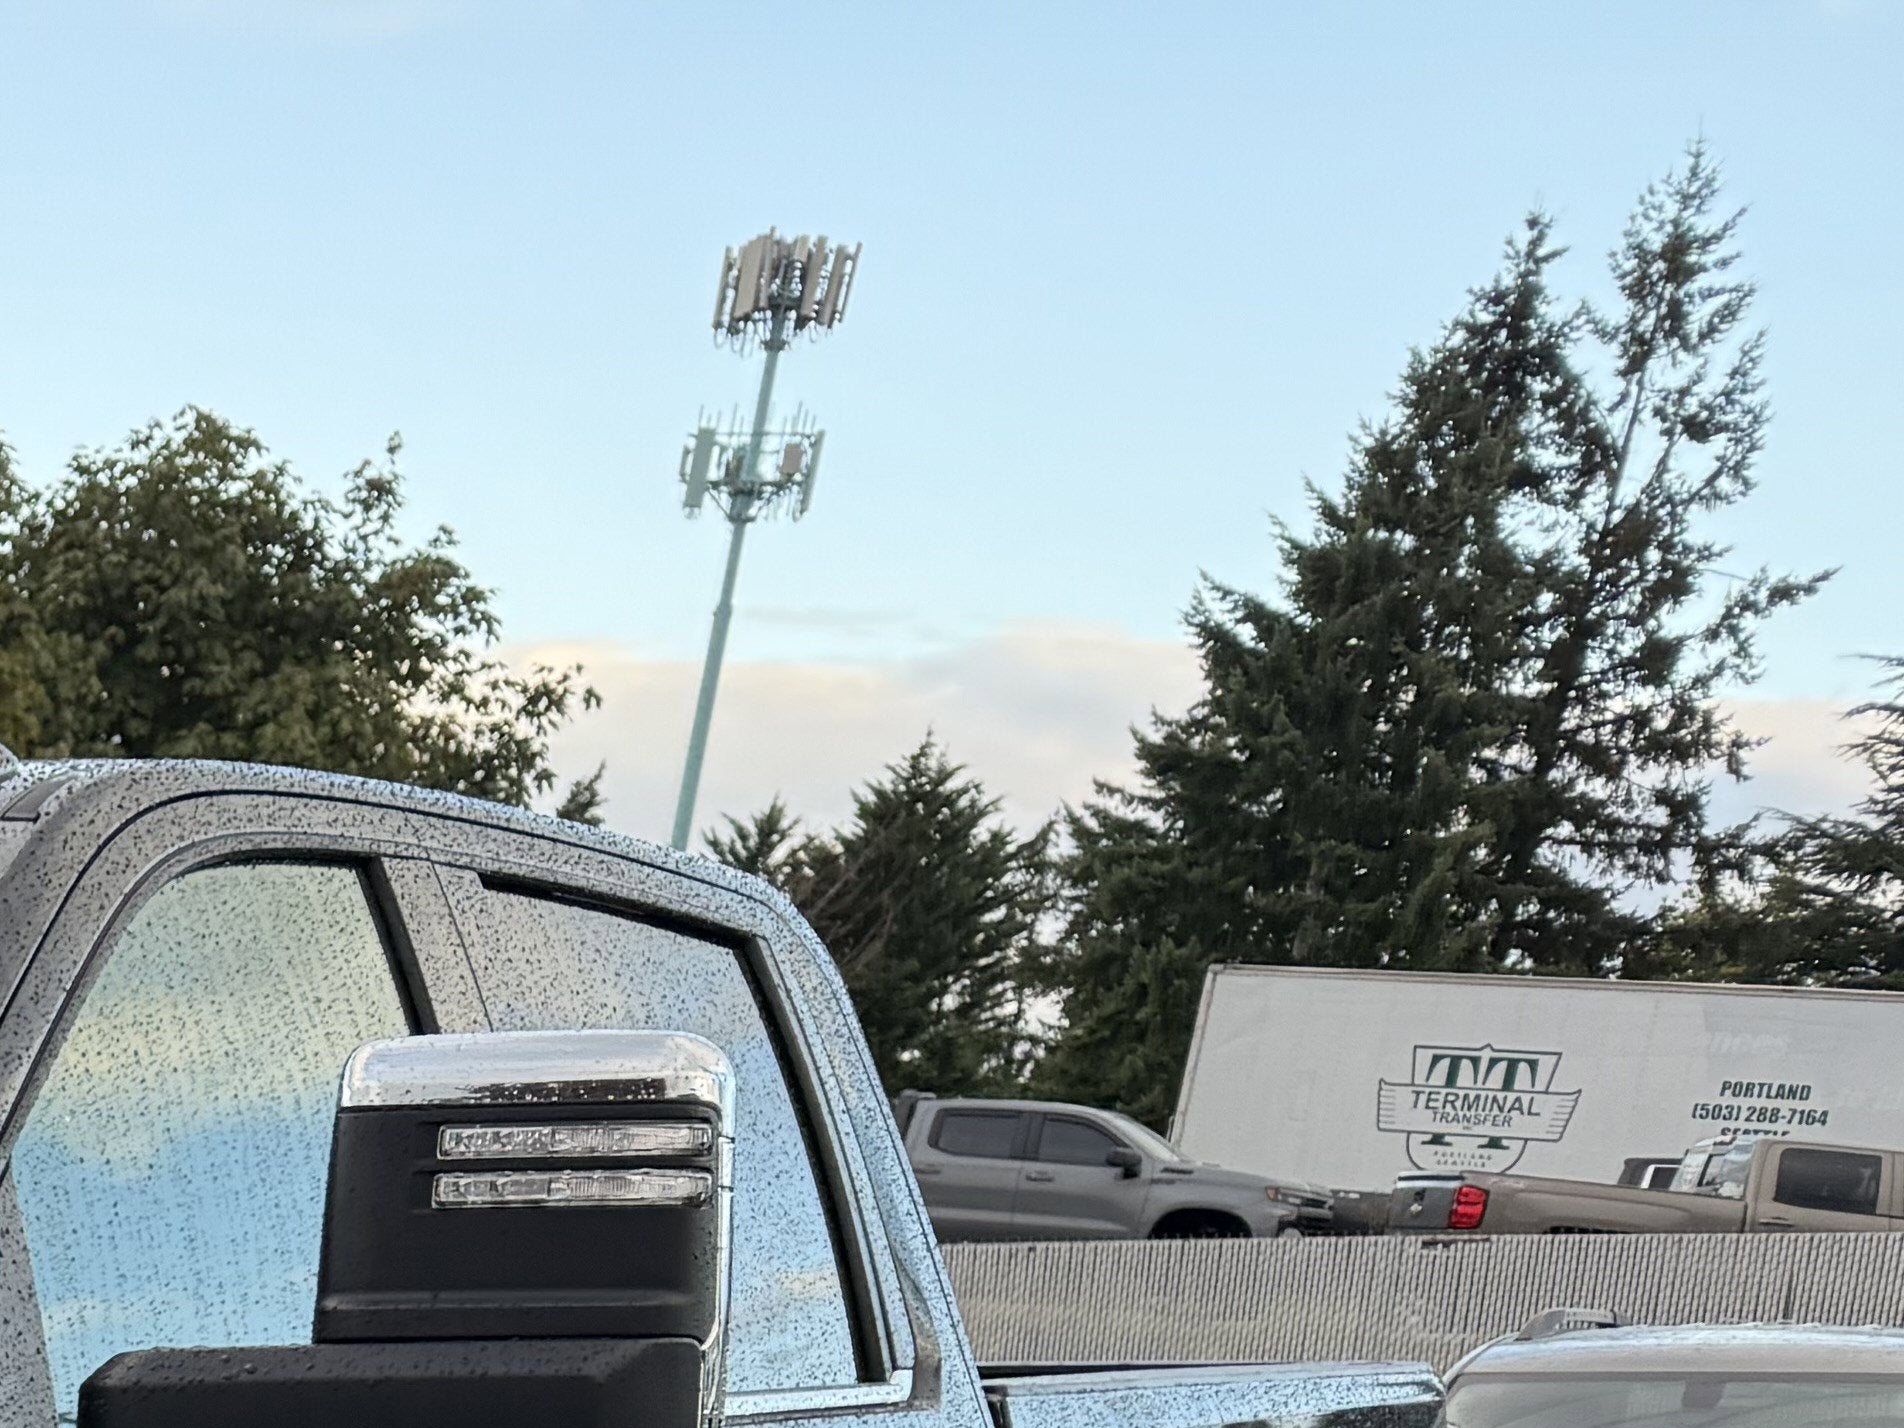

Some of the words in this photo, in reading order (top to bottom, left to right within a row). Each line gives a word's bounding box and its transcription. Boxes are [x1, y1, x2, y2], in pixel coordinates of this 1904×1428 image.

[1719, 1080, 1812, 1101] PORTLAND
[1411, 1090, 1541, 1116] TERMINAL
[1432, 1111, 1513, 1127] TRANSFER
[1692, 1103, 1741, 1121] (503)
[1744, 1106, 1829, 1126] 288-7164
